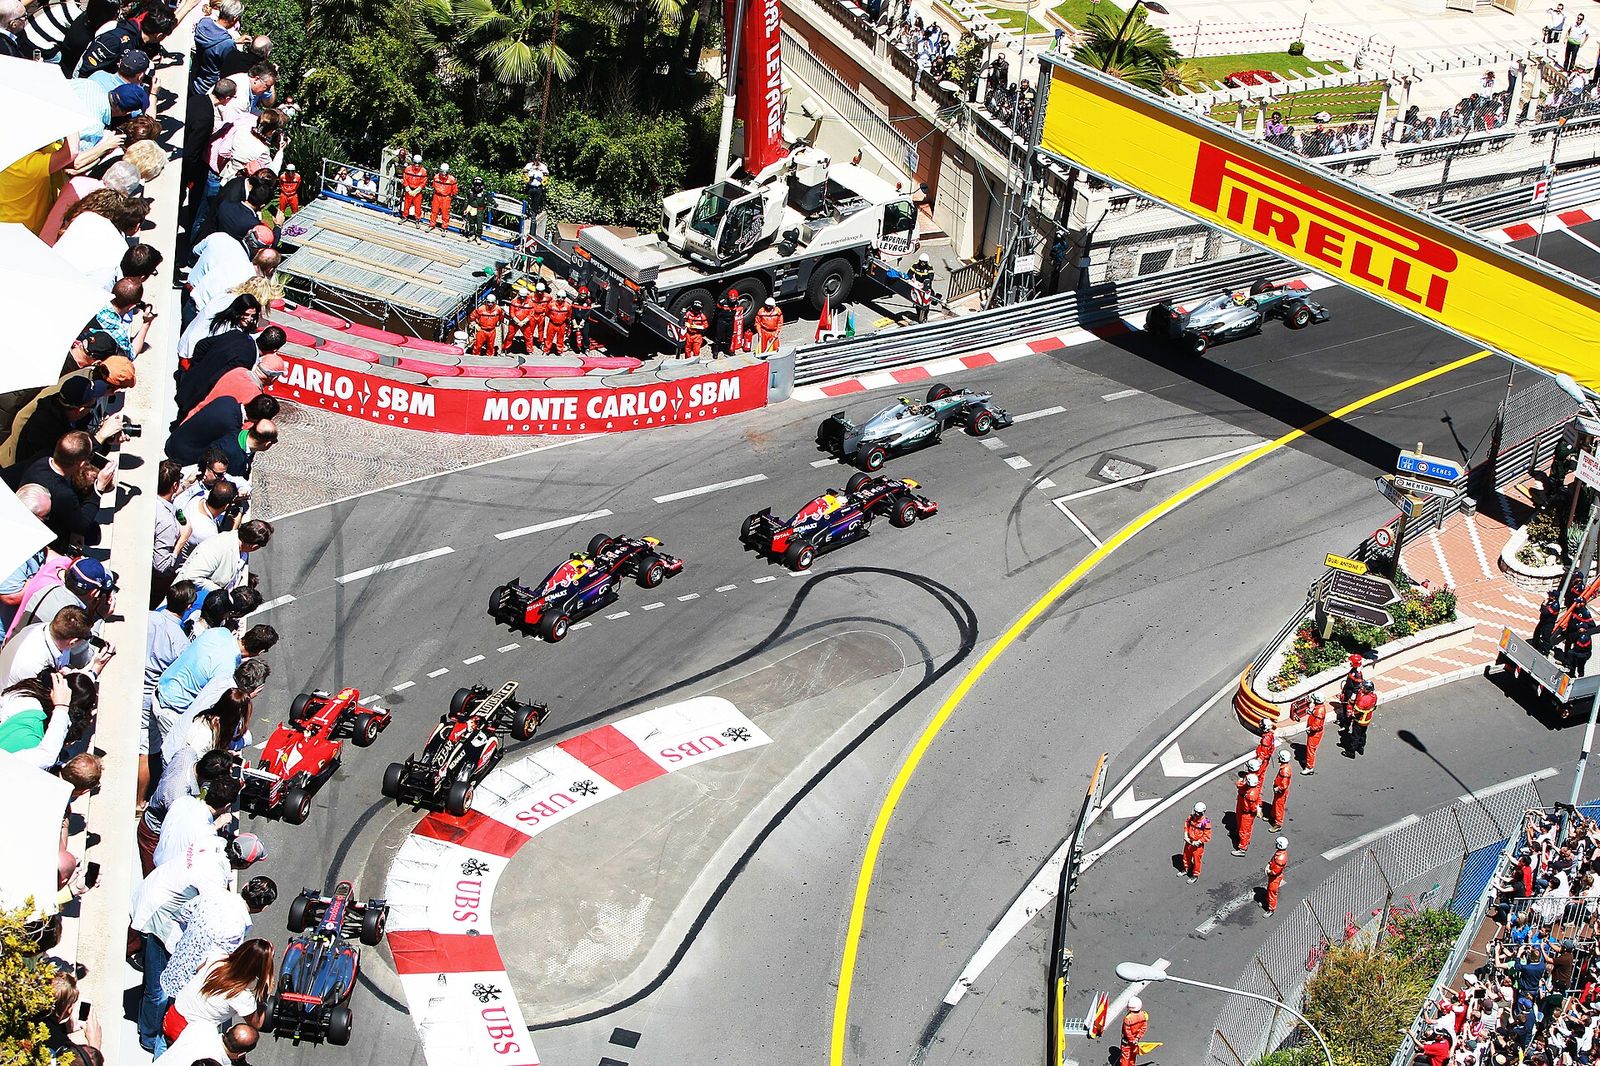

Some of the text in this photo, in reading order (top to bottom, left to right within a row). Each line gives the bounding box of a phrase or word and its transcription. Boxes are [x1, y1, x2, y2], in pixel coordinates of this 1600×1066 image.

[763, 0, 781, 138] IAL LEVAGE
[1534, 182, 1546, 200] F
[1190, 141, 1458, 313] PIRELLI
[879, 242, 909, 252] LEVAGE
[319, 398, 409, 424] CASINOS
[377, 385, 435, 417] SBM
[482, 376, 740, 421] MONTE CARLO SBM
[506, 423, 586, 431] HOTELS
[633, 407, 718, 426] CASINOS
[1405, 481, 1434, 492] MENTON
[773, 532, 790, 541] TOTAL
[661, 735, 728, 762] UBS
[515, 792, 577, 826] UBS
[453, 880, 483, 923] UBS
[481, 1005, 521, 1055] UBS
